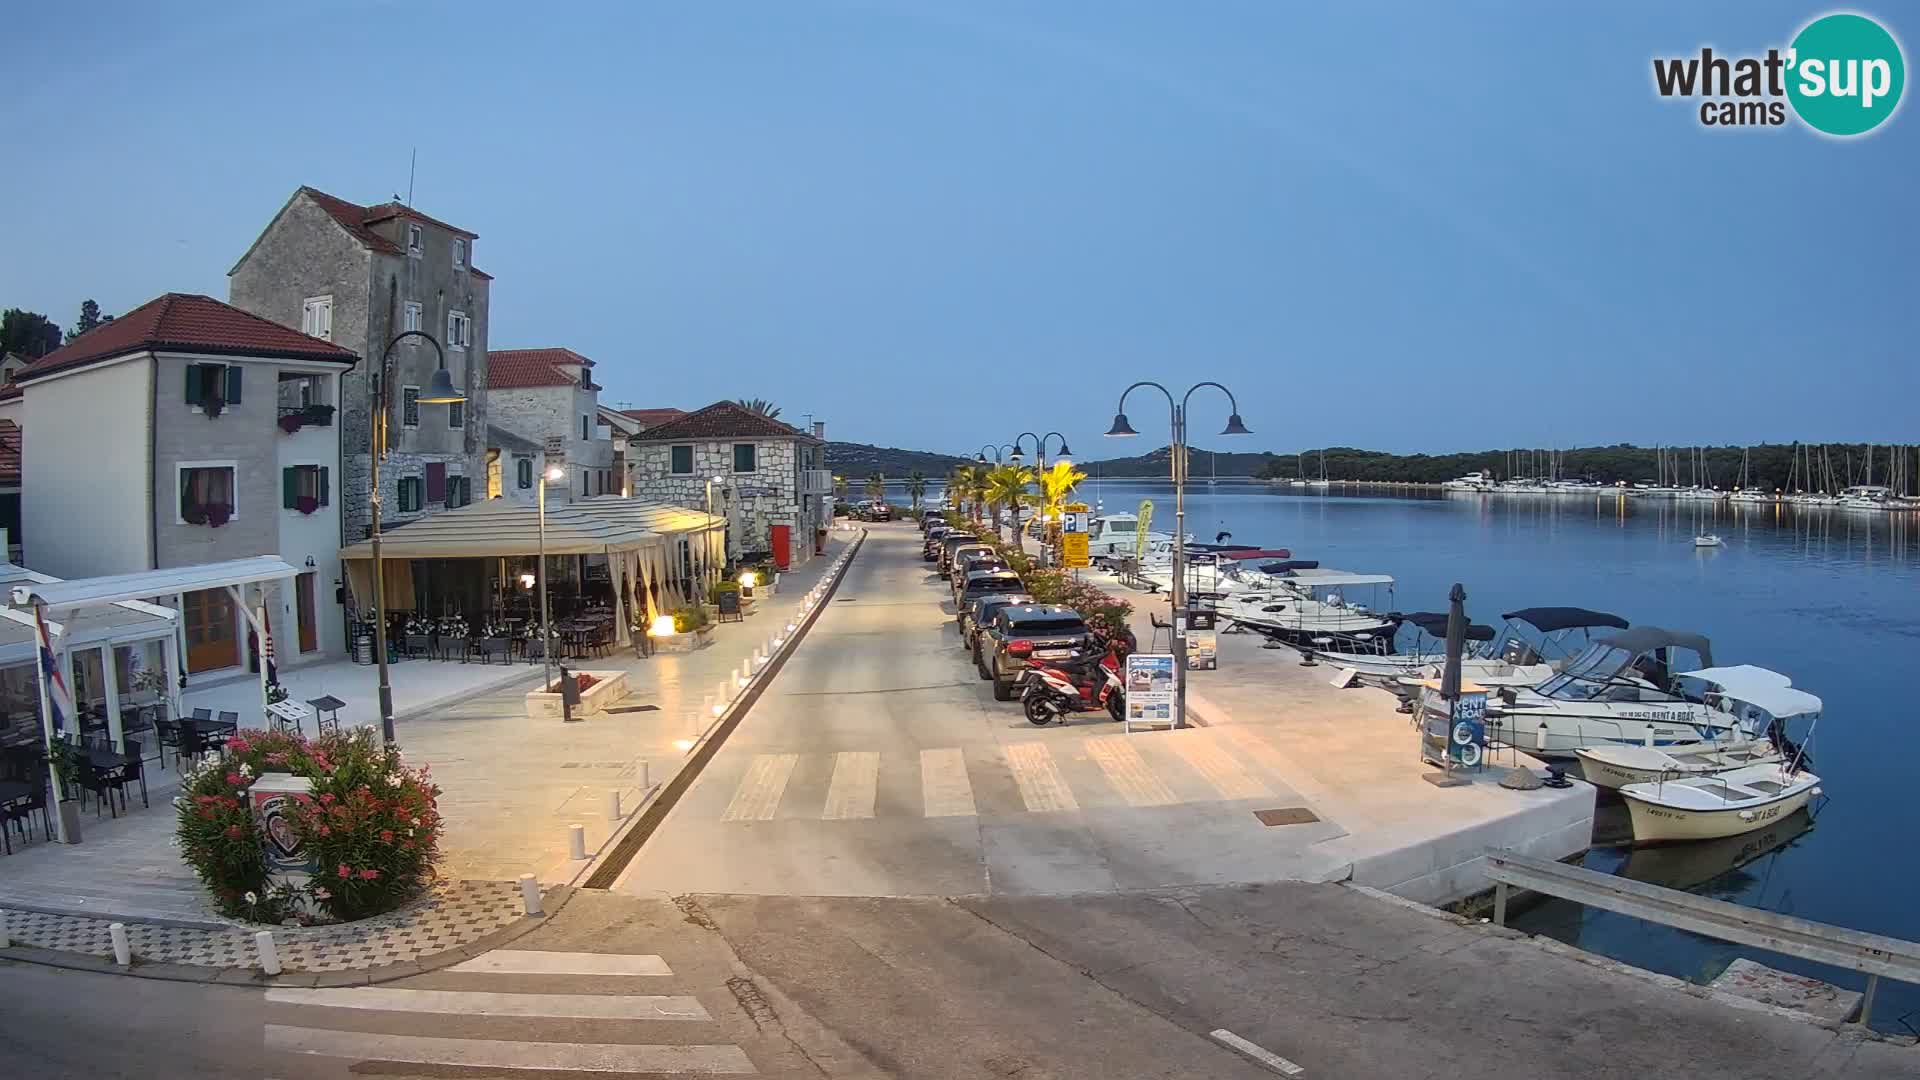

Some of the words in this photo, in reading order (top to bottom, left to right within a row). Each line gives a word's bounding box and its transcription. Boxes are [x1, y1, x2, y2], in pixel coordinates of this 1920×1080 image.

[1065, 514, 1076, 531] P
[1453, 696, 1485, 711] RENT
[1453, 711, 1460, 719] A
[1461, 709, 1484, 719] BOAT
[1651, 711, 1670, 720] RENT
[1671, 711, 1676, 720] A
[1677, 711, 1696, 721] BOAT
